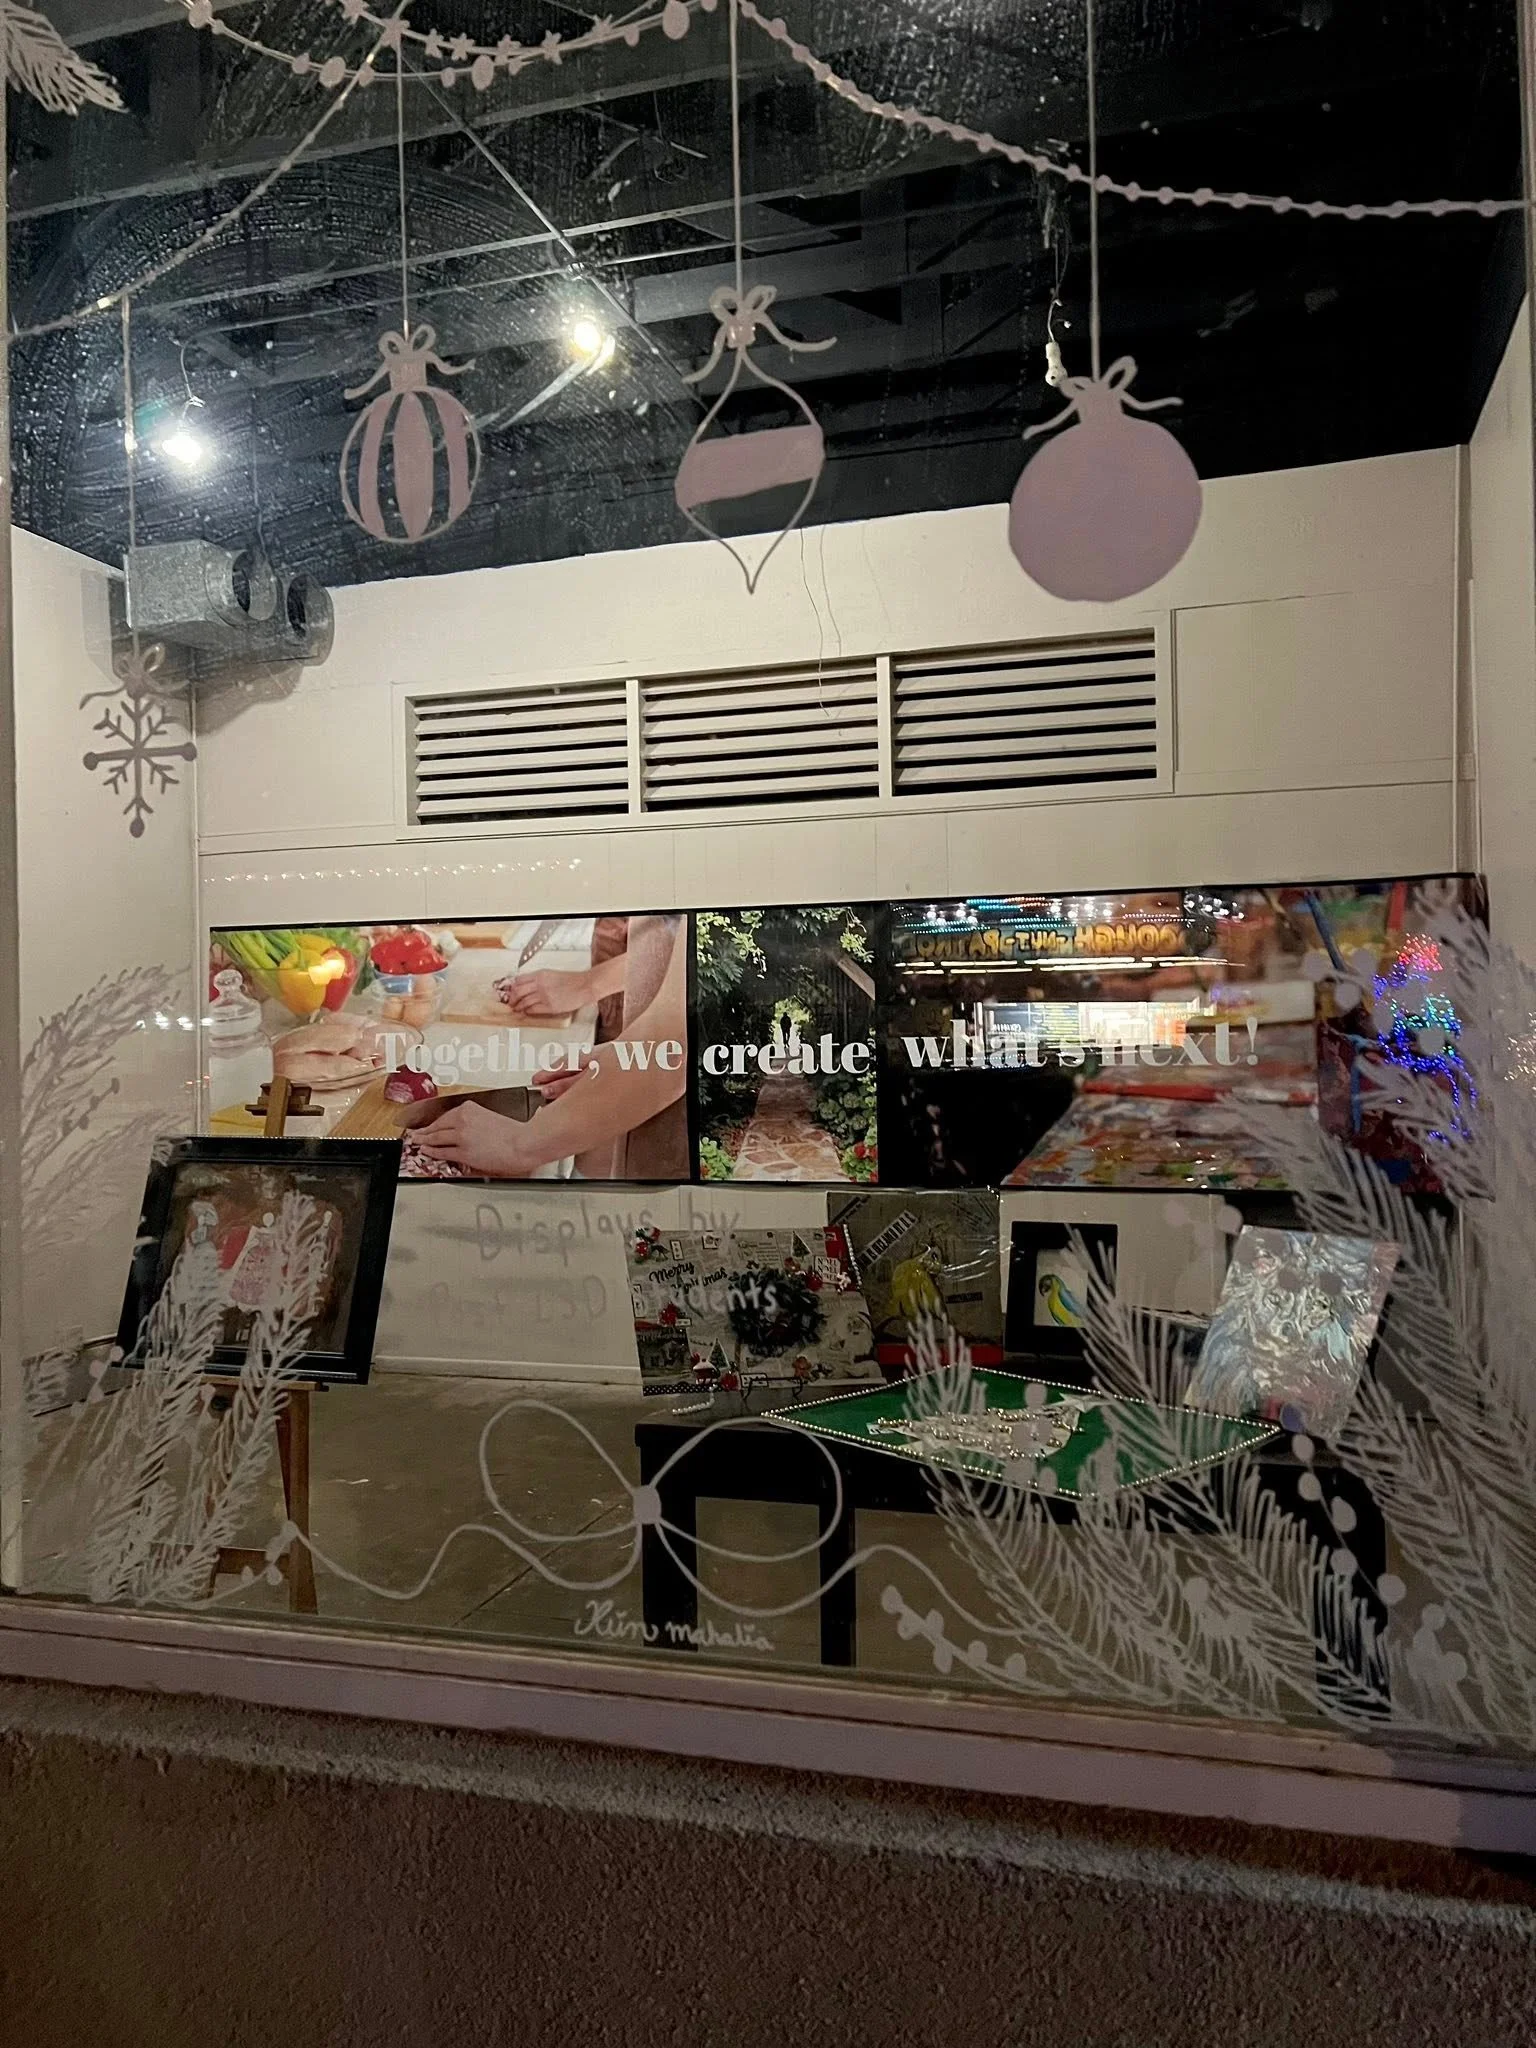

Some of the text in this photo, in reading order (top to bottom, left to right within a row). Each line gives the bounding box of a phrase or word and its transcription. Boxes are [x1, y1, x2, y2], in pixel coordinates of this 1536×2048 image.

[375, 1029, 600, 1086] Together,
[613, 1038, 684, 1071] we
[702, 1035, 872, 1077] create
[902, 1018, 1086, 1069] whats
[649, 1261, 694, 1284] Merry
